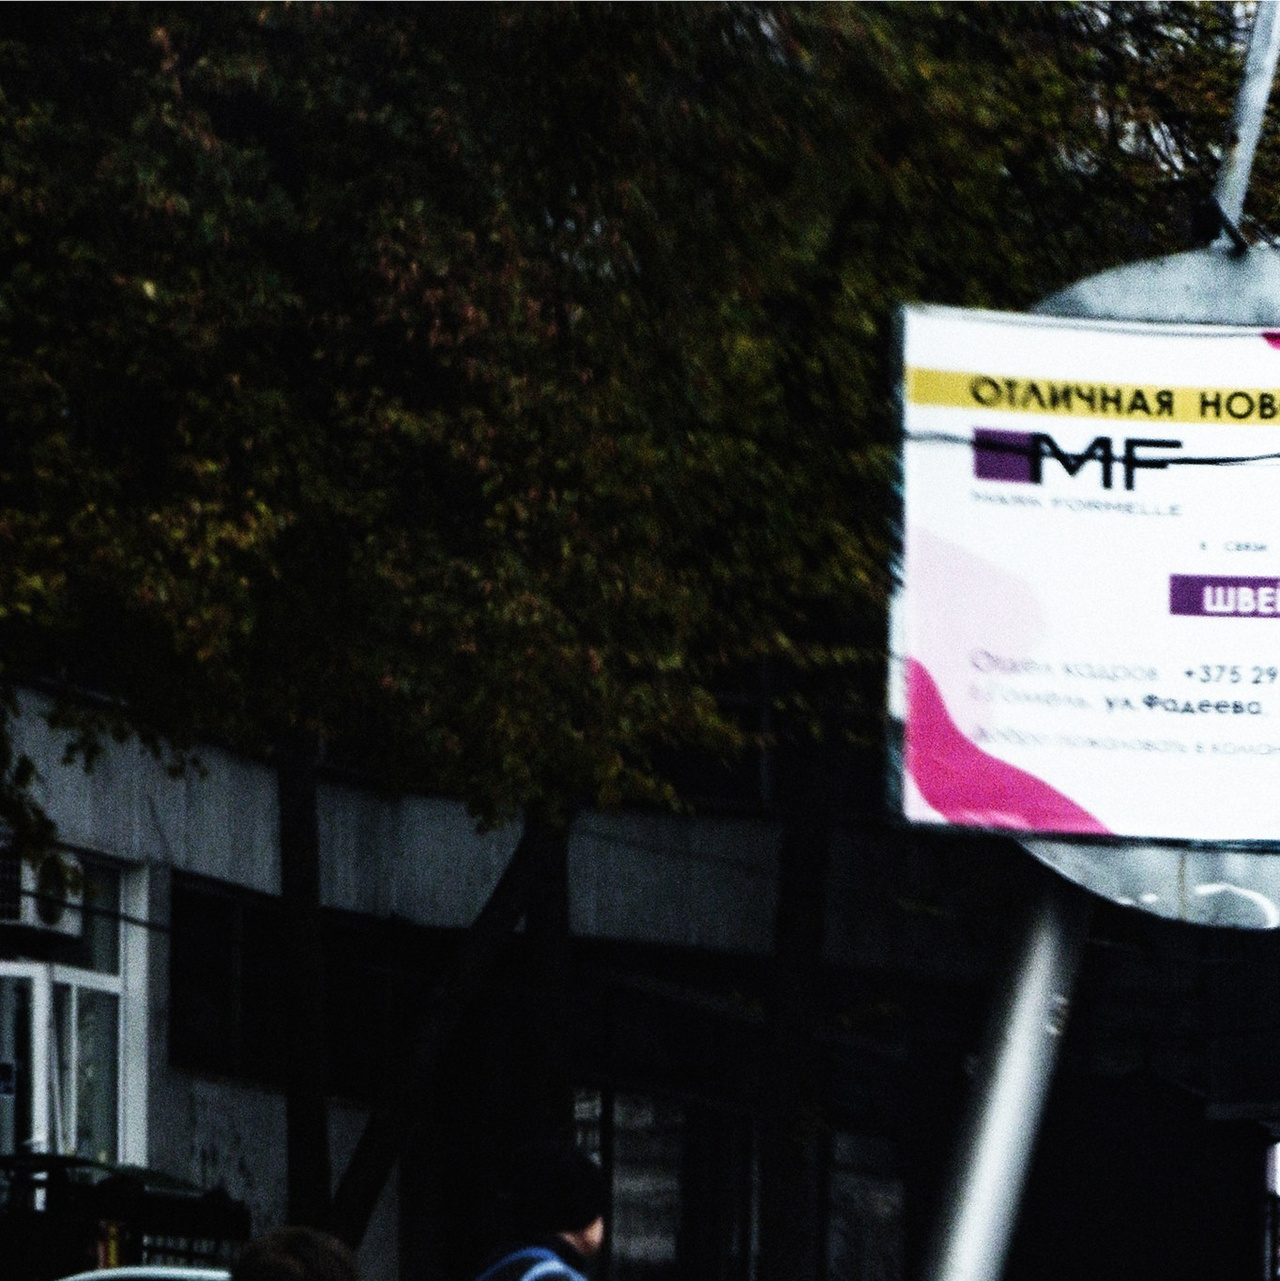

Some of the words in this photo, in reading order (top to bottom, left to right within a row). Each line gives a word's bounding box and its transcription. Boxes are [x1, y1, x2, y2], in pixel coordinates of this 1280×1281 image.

[969, 376, 1175, 419] ОТЛИЧНАЯ
[1030, 431, 1182, 491] MF
[1251, 665, 1278, 685] 29
